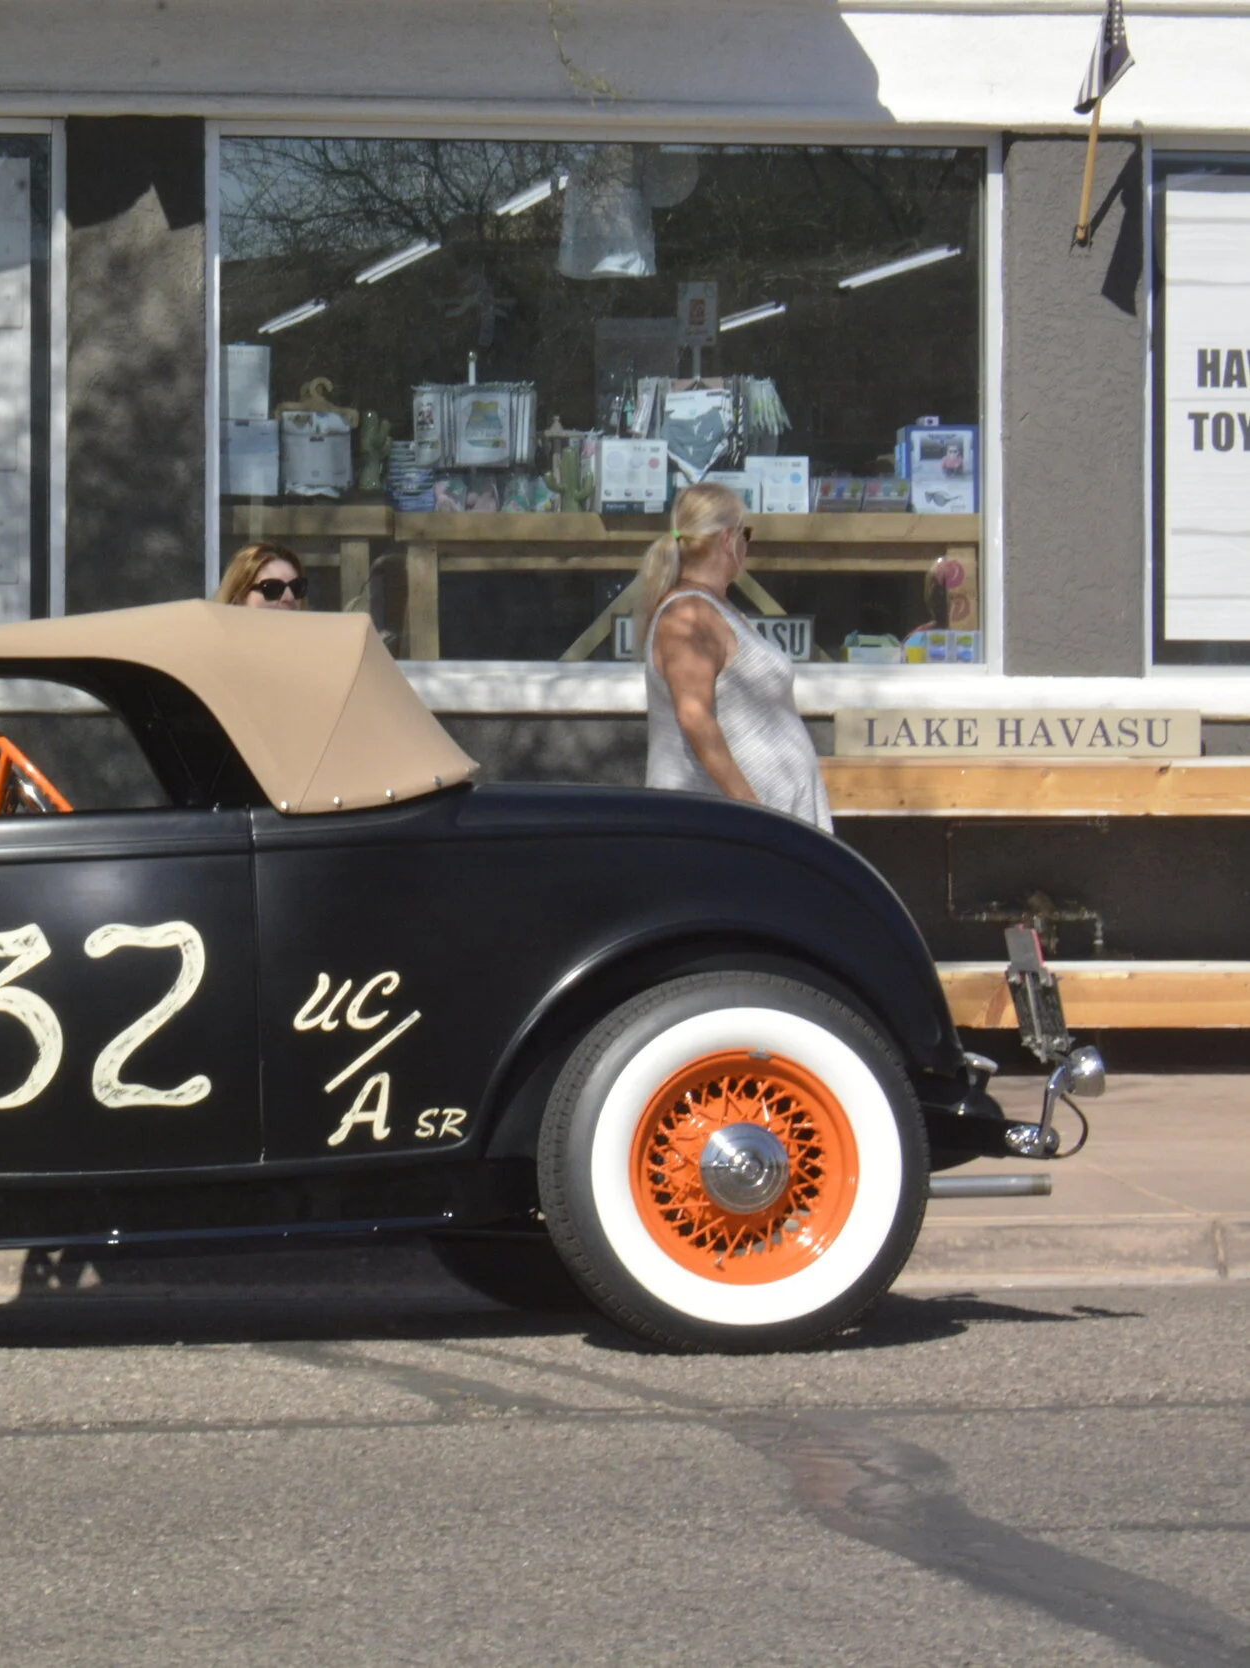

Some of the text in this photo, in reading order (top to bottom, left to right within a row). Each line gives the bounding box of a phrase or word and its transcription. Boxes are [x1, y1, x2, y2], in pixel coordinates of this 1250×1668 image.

[1197, 348, 1250, 388] HA
[864, 717, 1172, 748] LAKE HAVASU
[414, 1107, 468, 1139] SR
